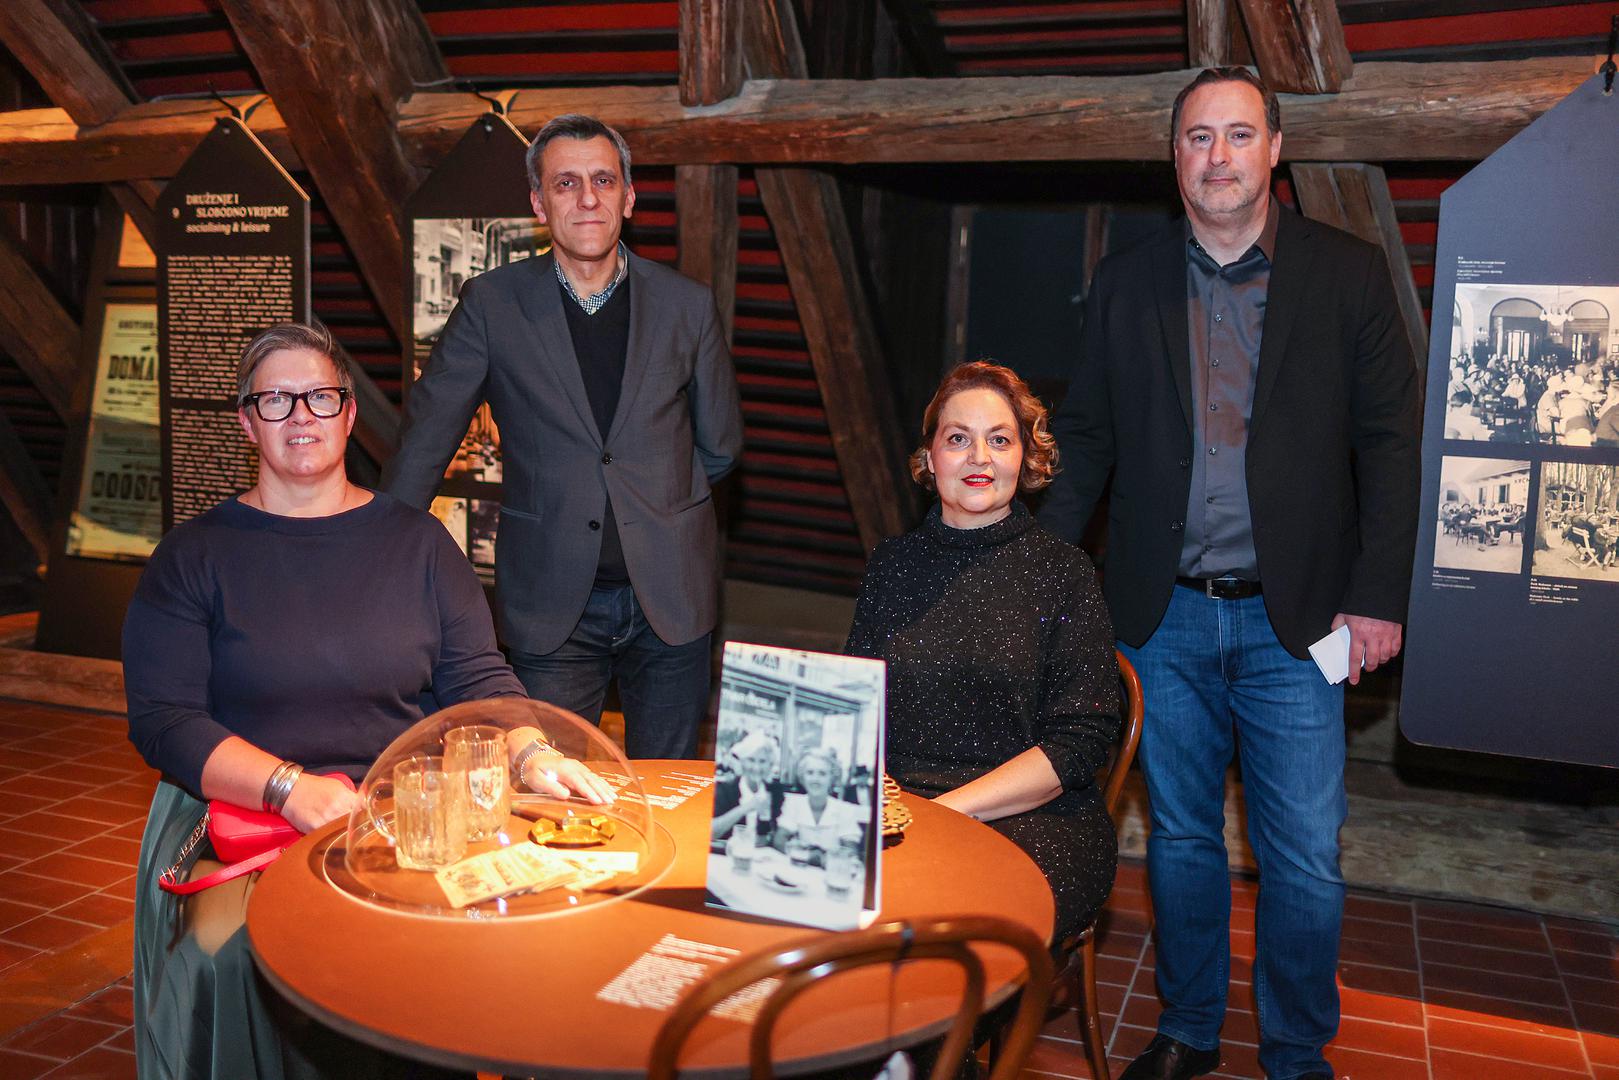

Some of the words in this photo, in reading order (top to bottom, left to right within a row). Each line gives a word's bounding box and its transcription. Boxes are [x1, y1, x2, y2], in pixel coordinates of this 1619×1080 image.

[186, 192, 232, 205] DRUŽENJE
[234, 193, 239, 204] I
[196, 207, 246, 217] SLOBODNO
[247, 206, 289, 219] VRIJEME
[241, 222, 271, 232] leisure
